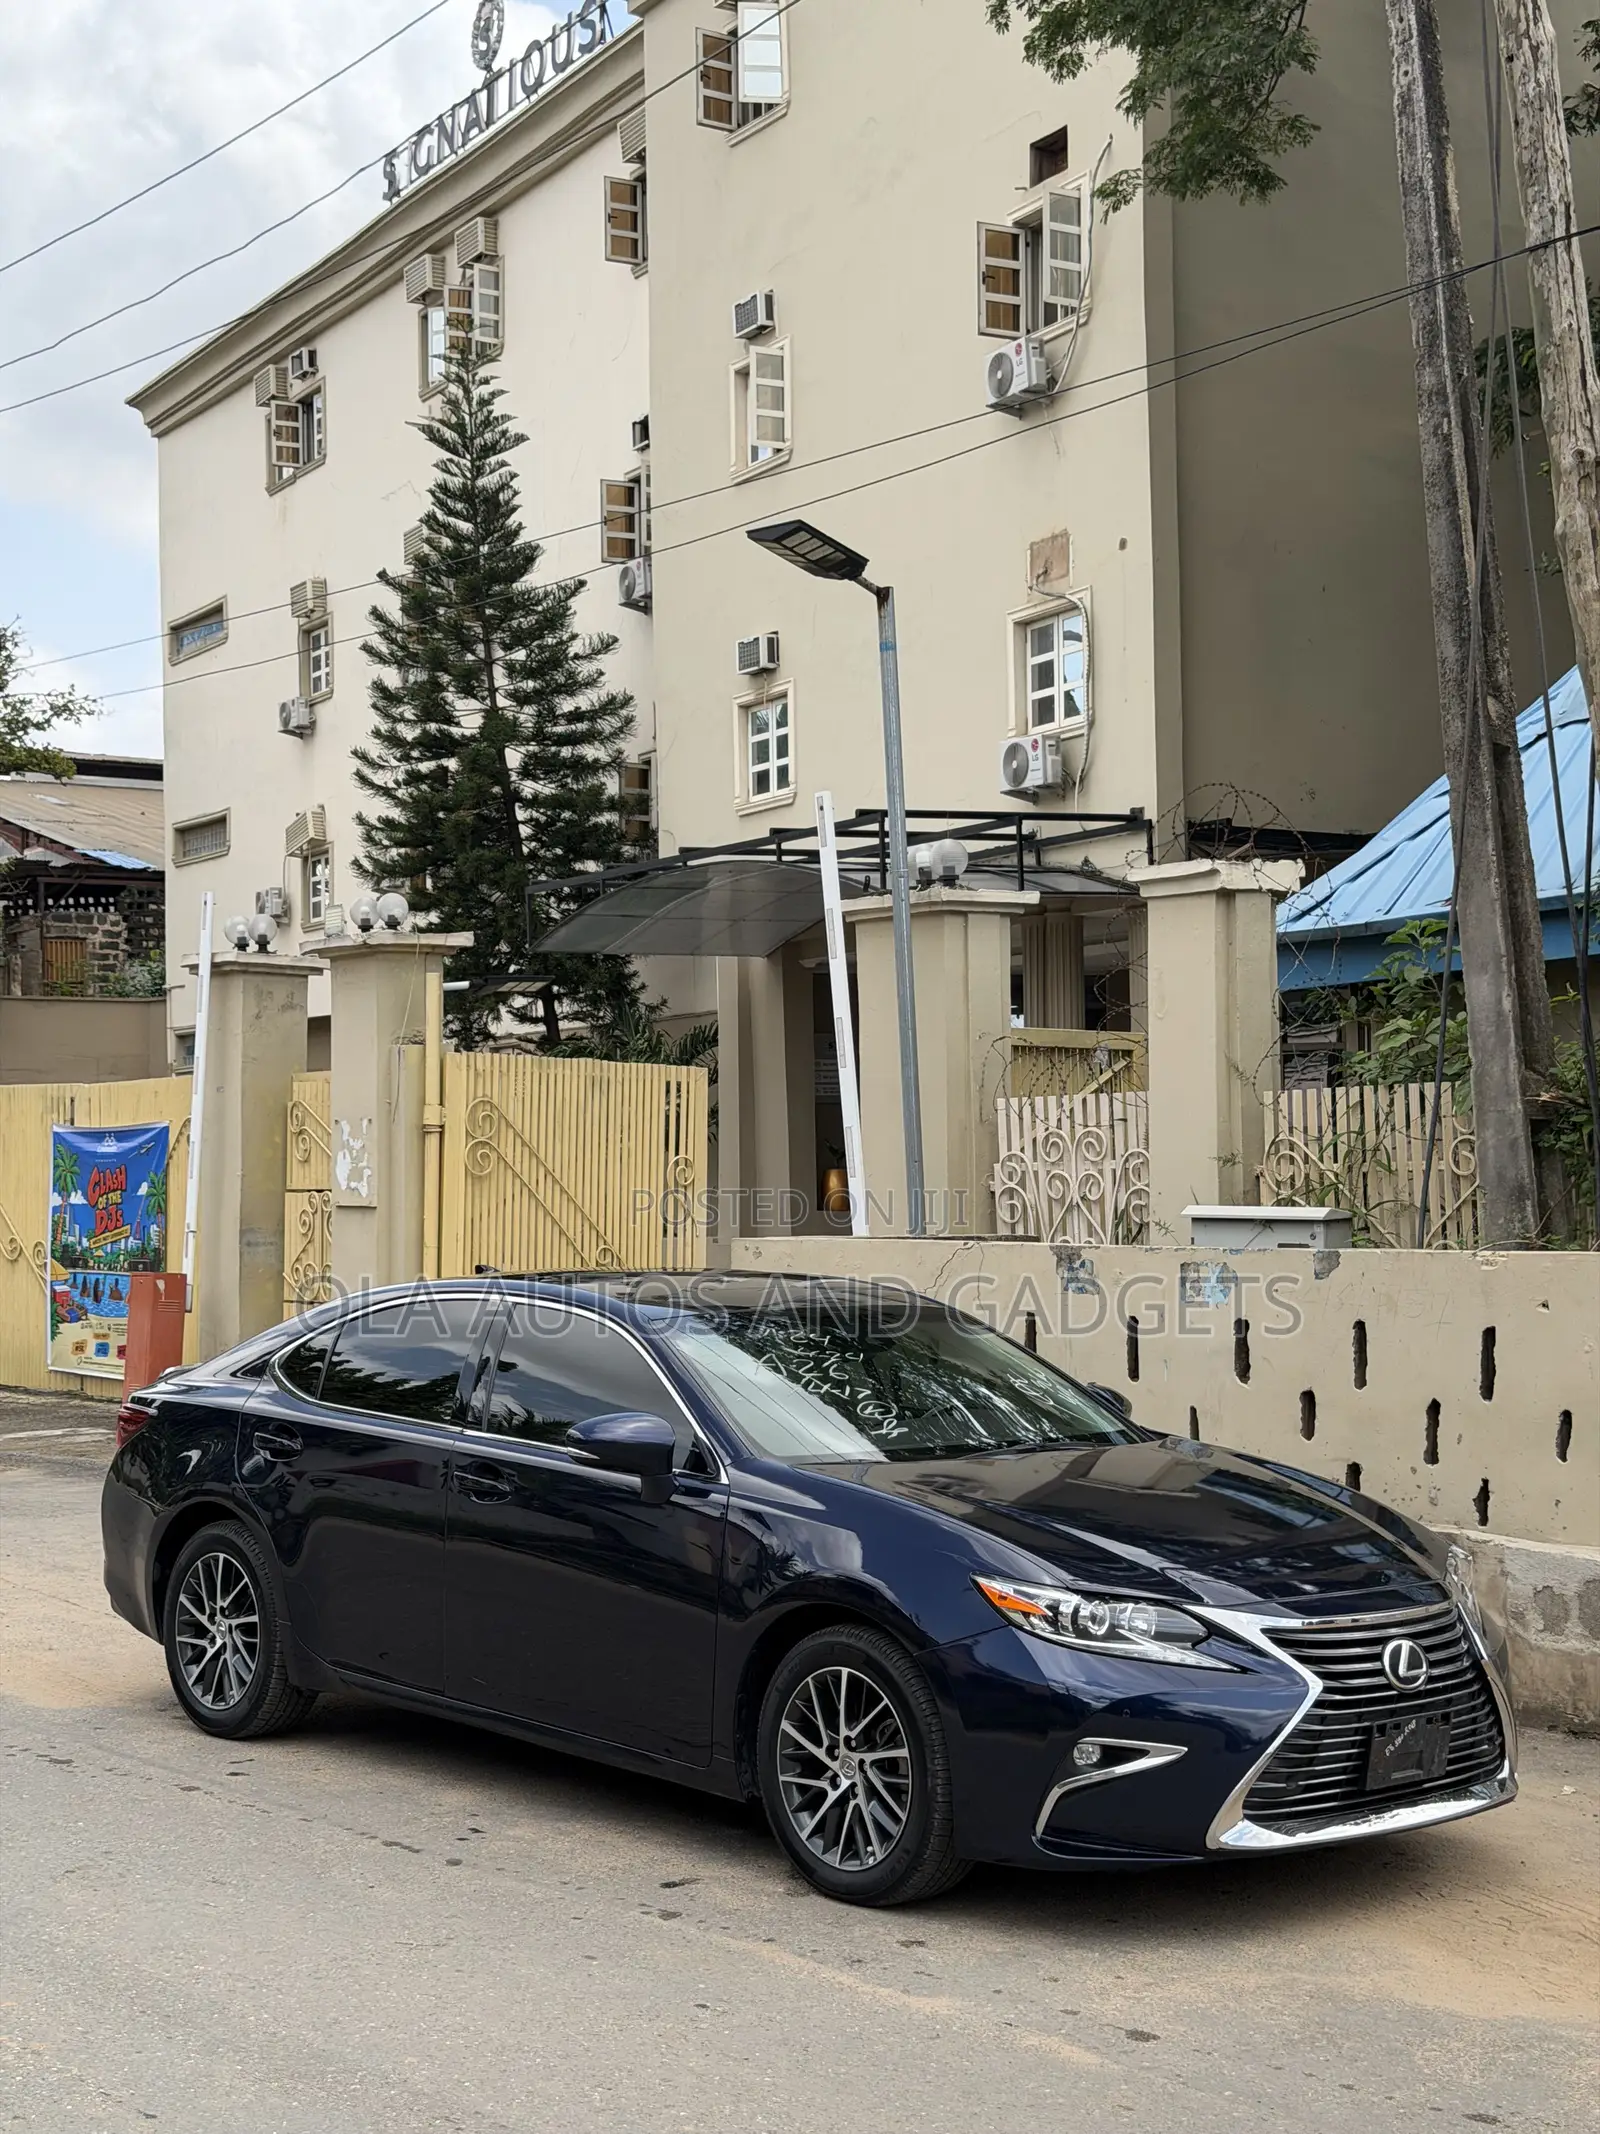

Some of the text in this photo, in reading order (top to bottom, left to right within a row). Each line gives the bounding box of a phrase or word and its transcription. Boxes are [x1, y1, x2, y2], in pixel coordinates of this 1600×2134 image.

[87, 1164, 126, 1207] CLASH
[98, 1190, 122, 1210] OF THE
